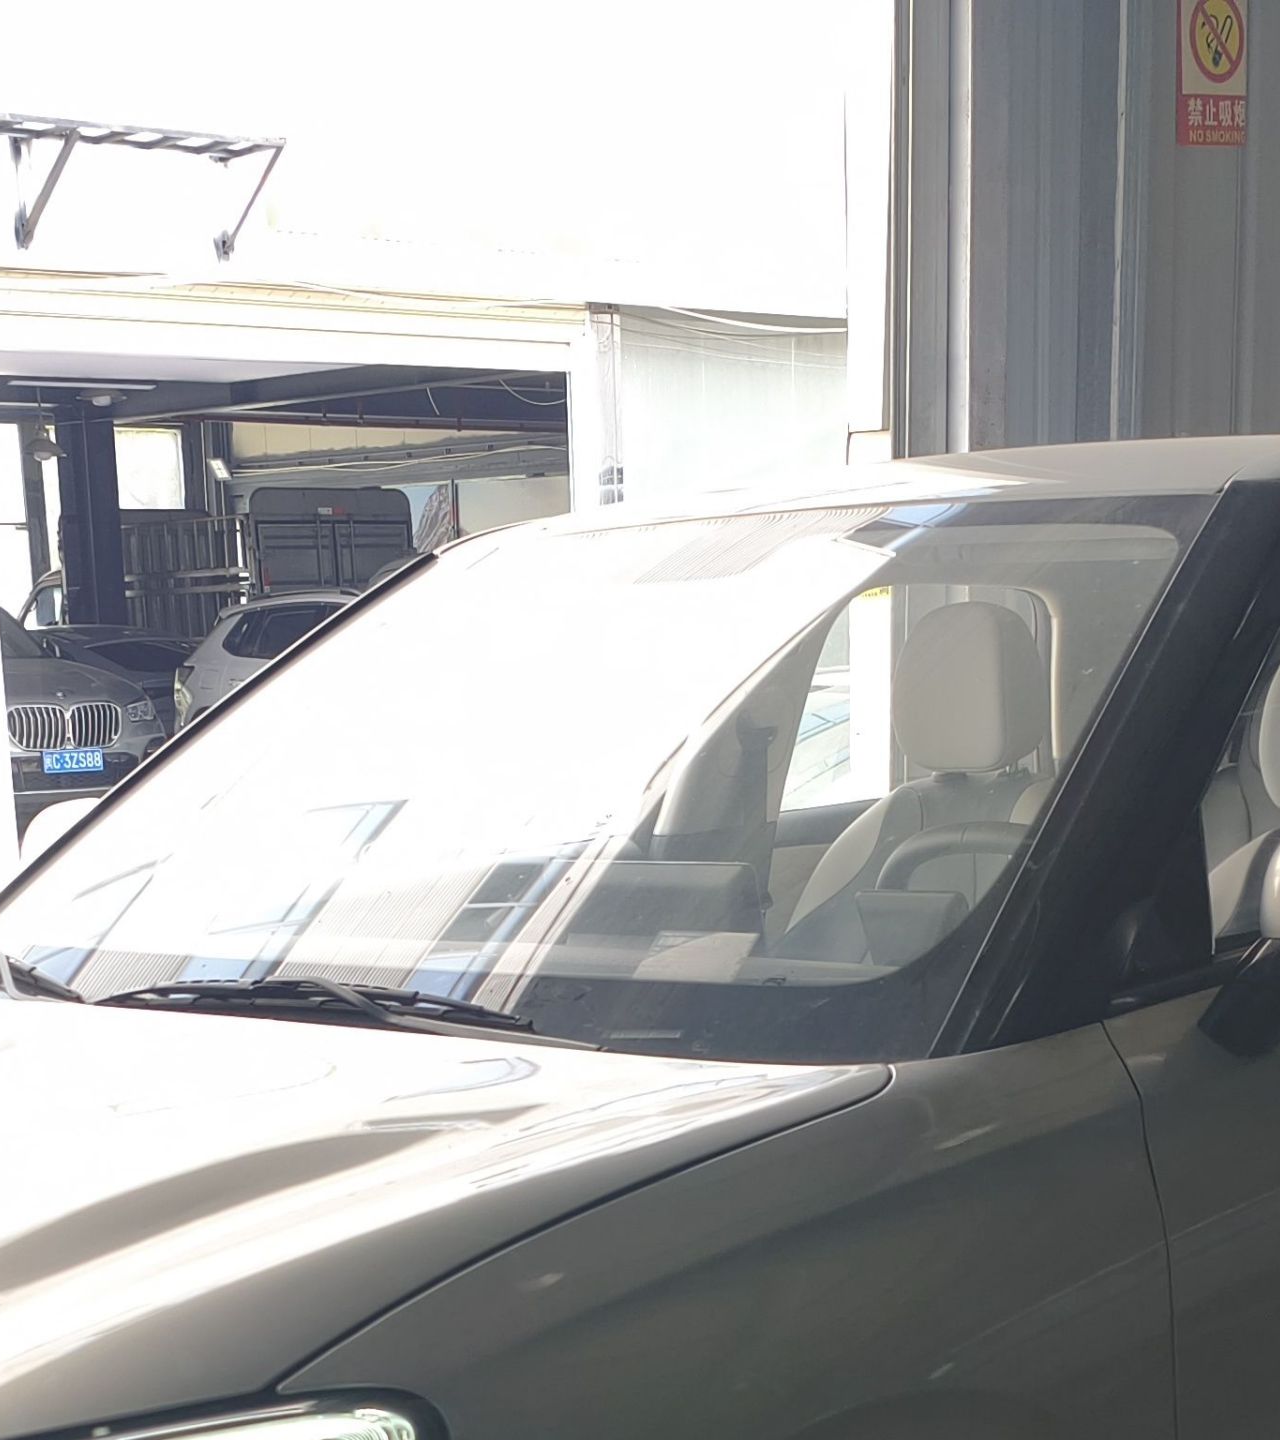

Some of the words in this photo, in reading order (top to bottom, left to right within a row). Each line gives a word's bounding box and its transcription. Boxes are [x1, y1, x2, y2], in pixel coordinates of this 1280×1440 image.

[1188, 97, 1246, 127] 禁止吸烟
[1189, 129, 1204, 143] NO
